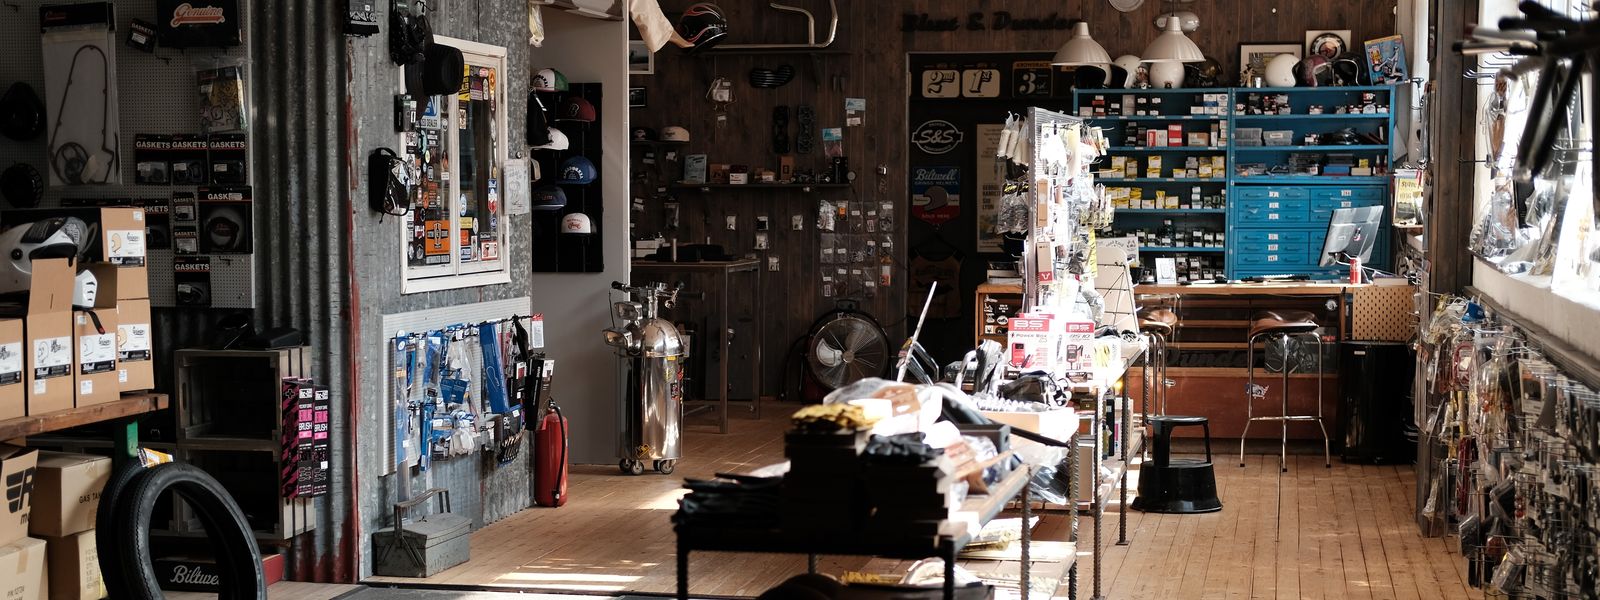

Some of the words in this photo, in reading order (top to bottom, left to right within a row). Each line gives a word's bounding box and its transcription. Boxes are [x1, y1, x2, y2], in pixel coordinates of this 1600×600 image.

[920, 130, 955, 144] S&S
[136, 141, 171, 149] GASKETS
[172, 141, 207, 149] GASKETS
[1014, 320, 1044, 328] BS
[299, 422, 312, 431] BRUSH
[314, 423, 328, 432] BRUSH
[170, 565, 220, 586] Biltwe
